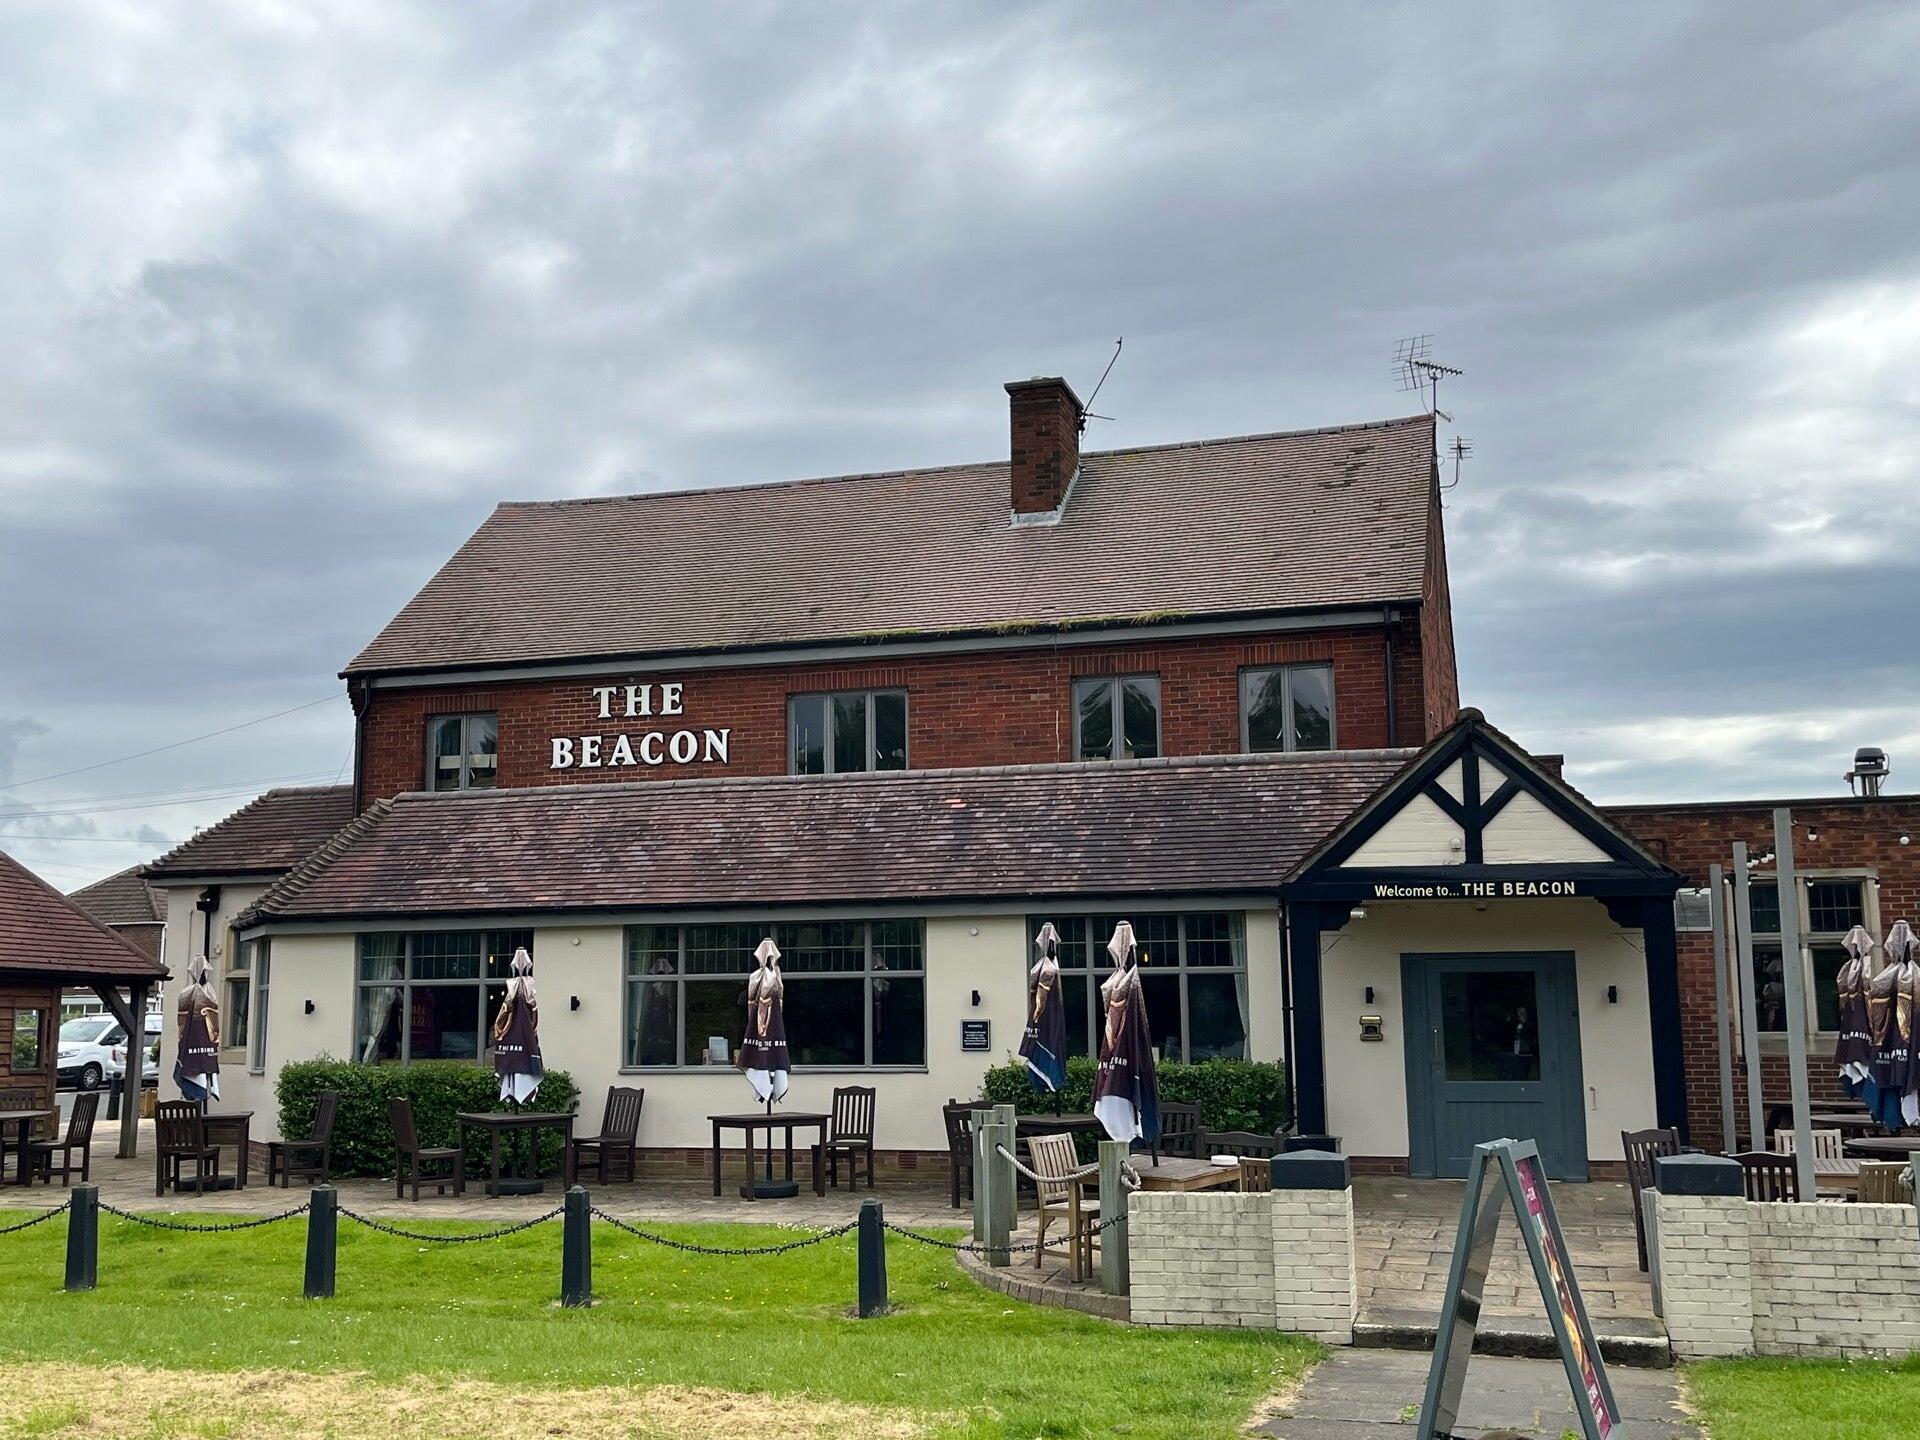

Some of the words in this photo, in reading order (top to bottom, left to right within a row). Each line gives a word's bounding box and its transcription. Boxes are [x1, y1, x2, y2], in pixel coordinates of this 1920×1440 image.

[592, 683, 684, 719] THE
[550, 728, 731, 769] BEACON
[1374, 885, 1433, 897] Welcome
[1462, 882, 1495, 896] THE
[1503, 881, 1576, 896] BEACON
